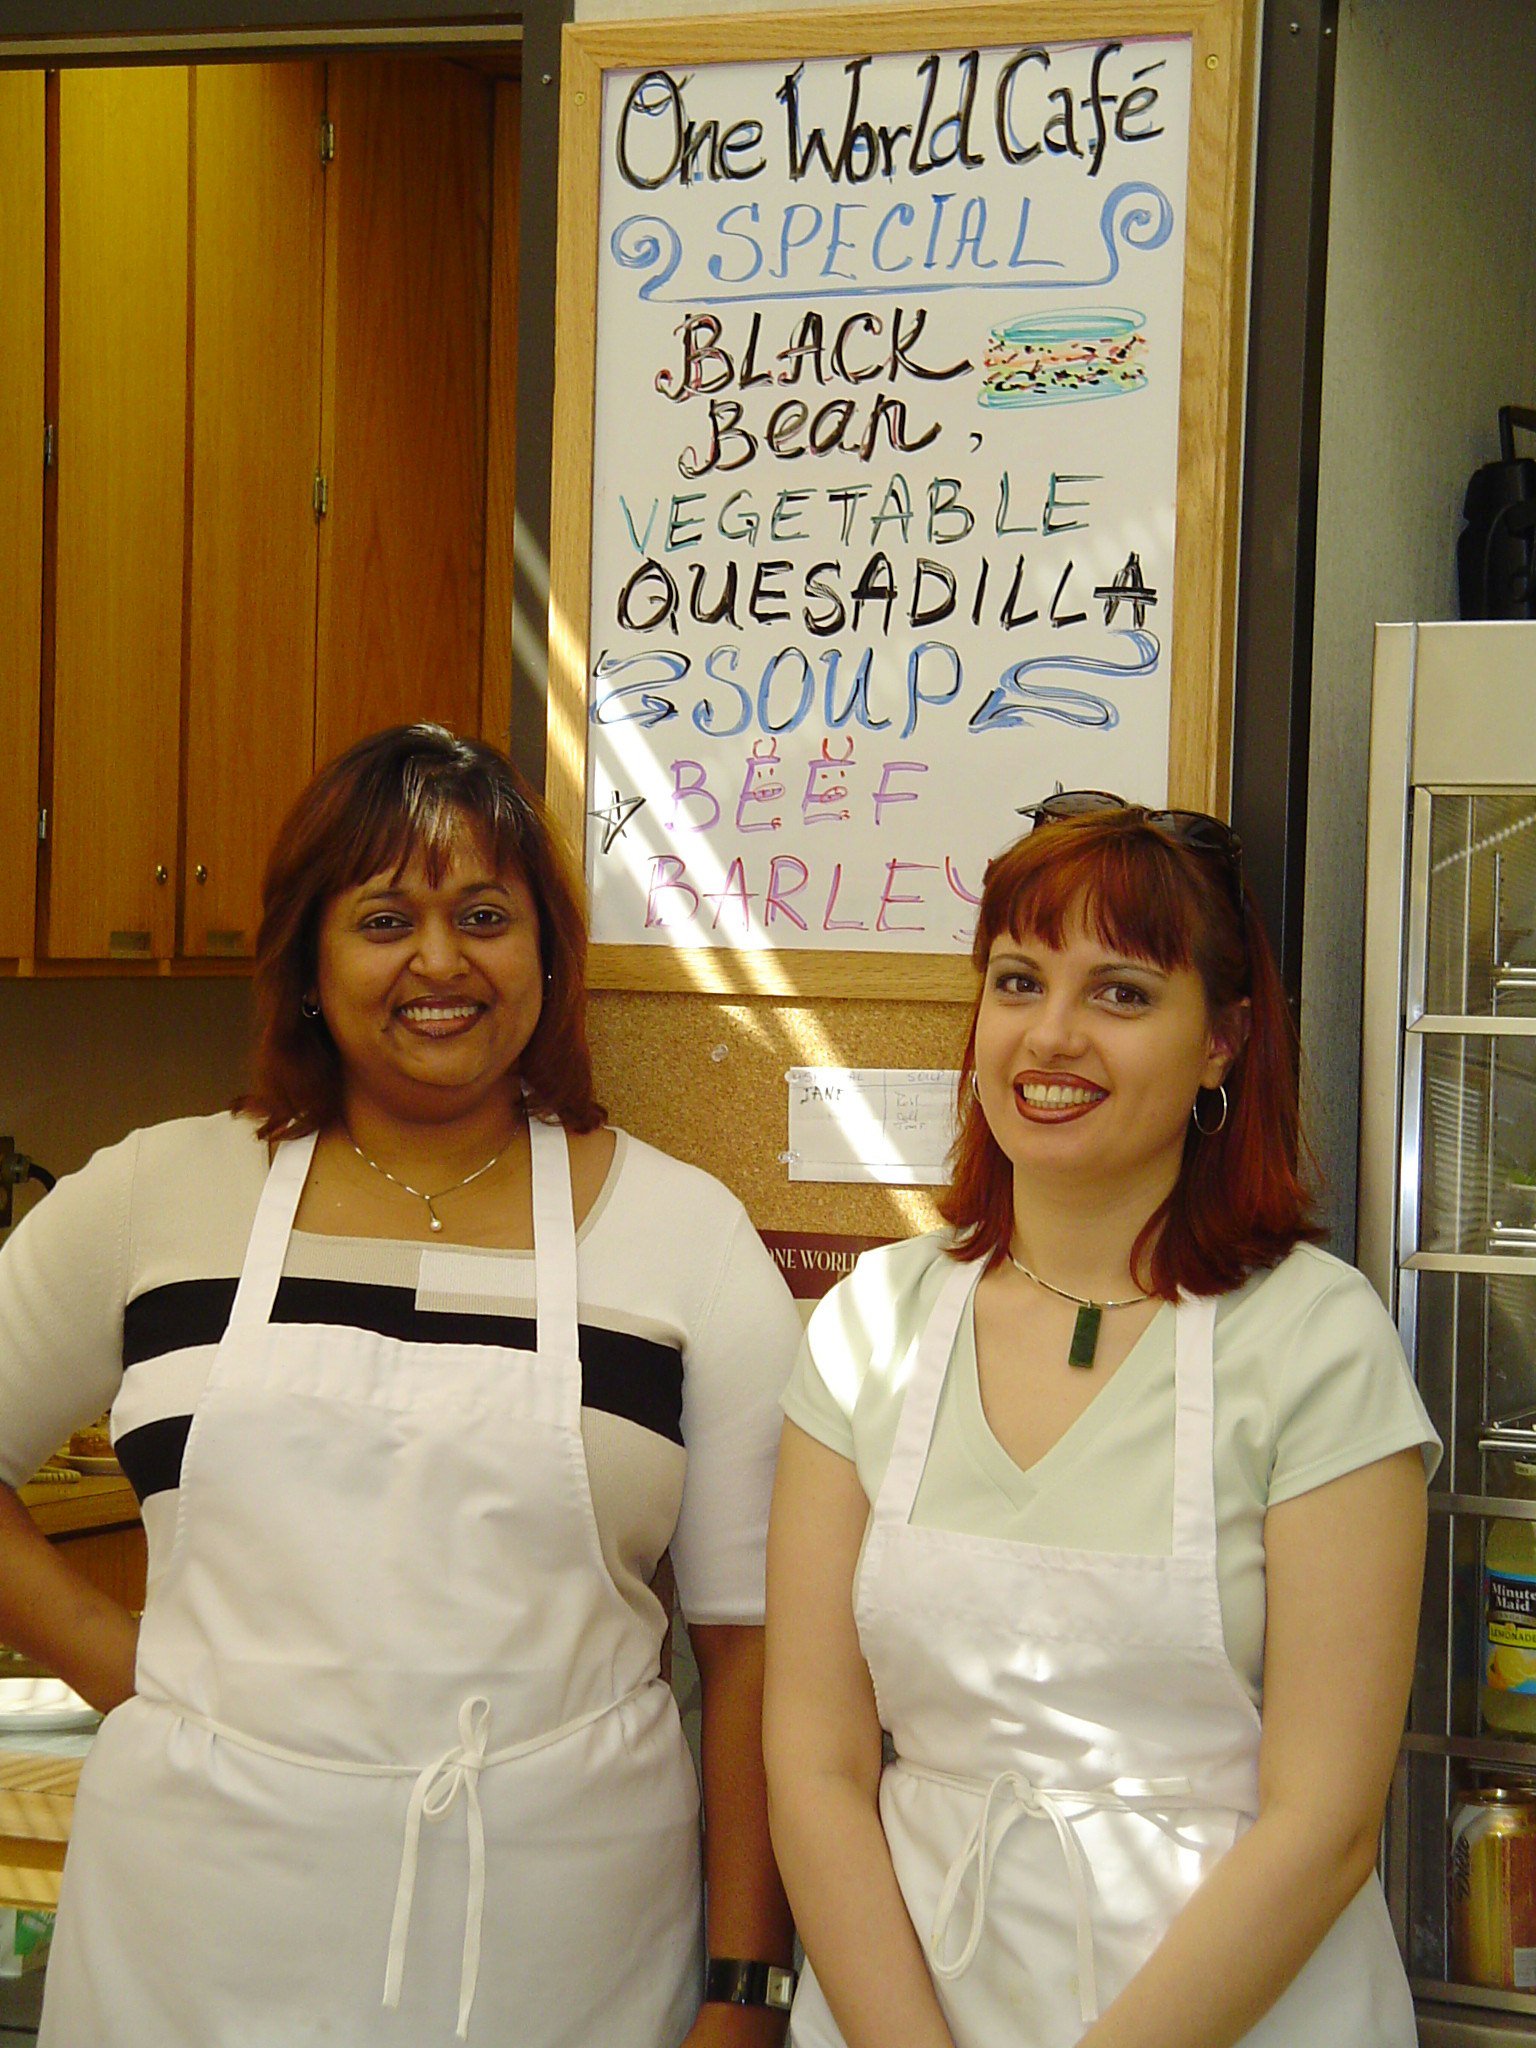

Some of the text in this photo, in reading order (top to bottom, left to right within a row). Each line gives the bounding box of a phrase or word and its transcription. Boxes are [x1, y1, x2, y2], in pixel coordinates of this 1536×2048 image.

[616, 43, 1166, 190] One World Café
[708, 194, 1066, 282] SPECIAL
[656, 307, 975, 404] BLACK
[619, 472, 1104, 554] VEGETABLE
[617, 552, 1158, 636] QUESADILLA
[692, 641, 963, 738] SOUP
[665, 738, 929, 832] BEEF
[1496, 1595, 1531, 1612] Maid
